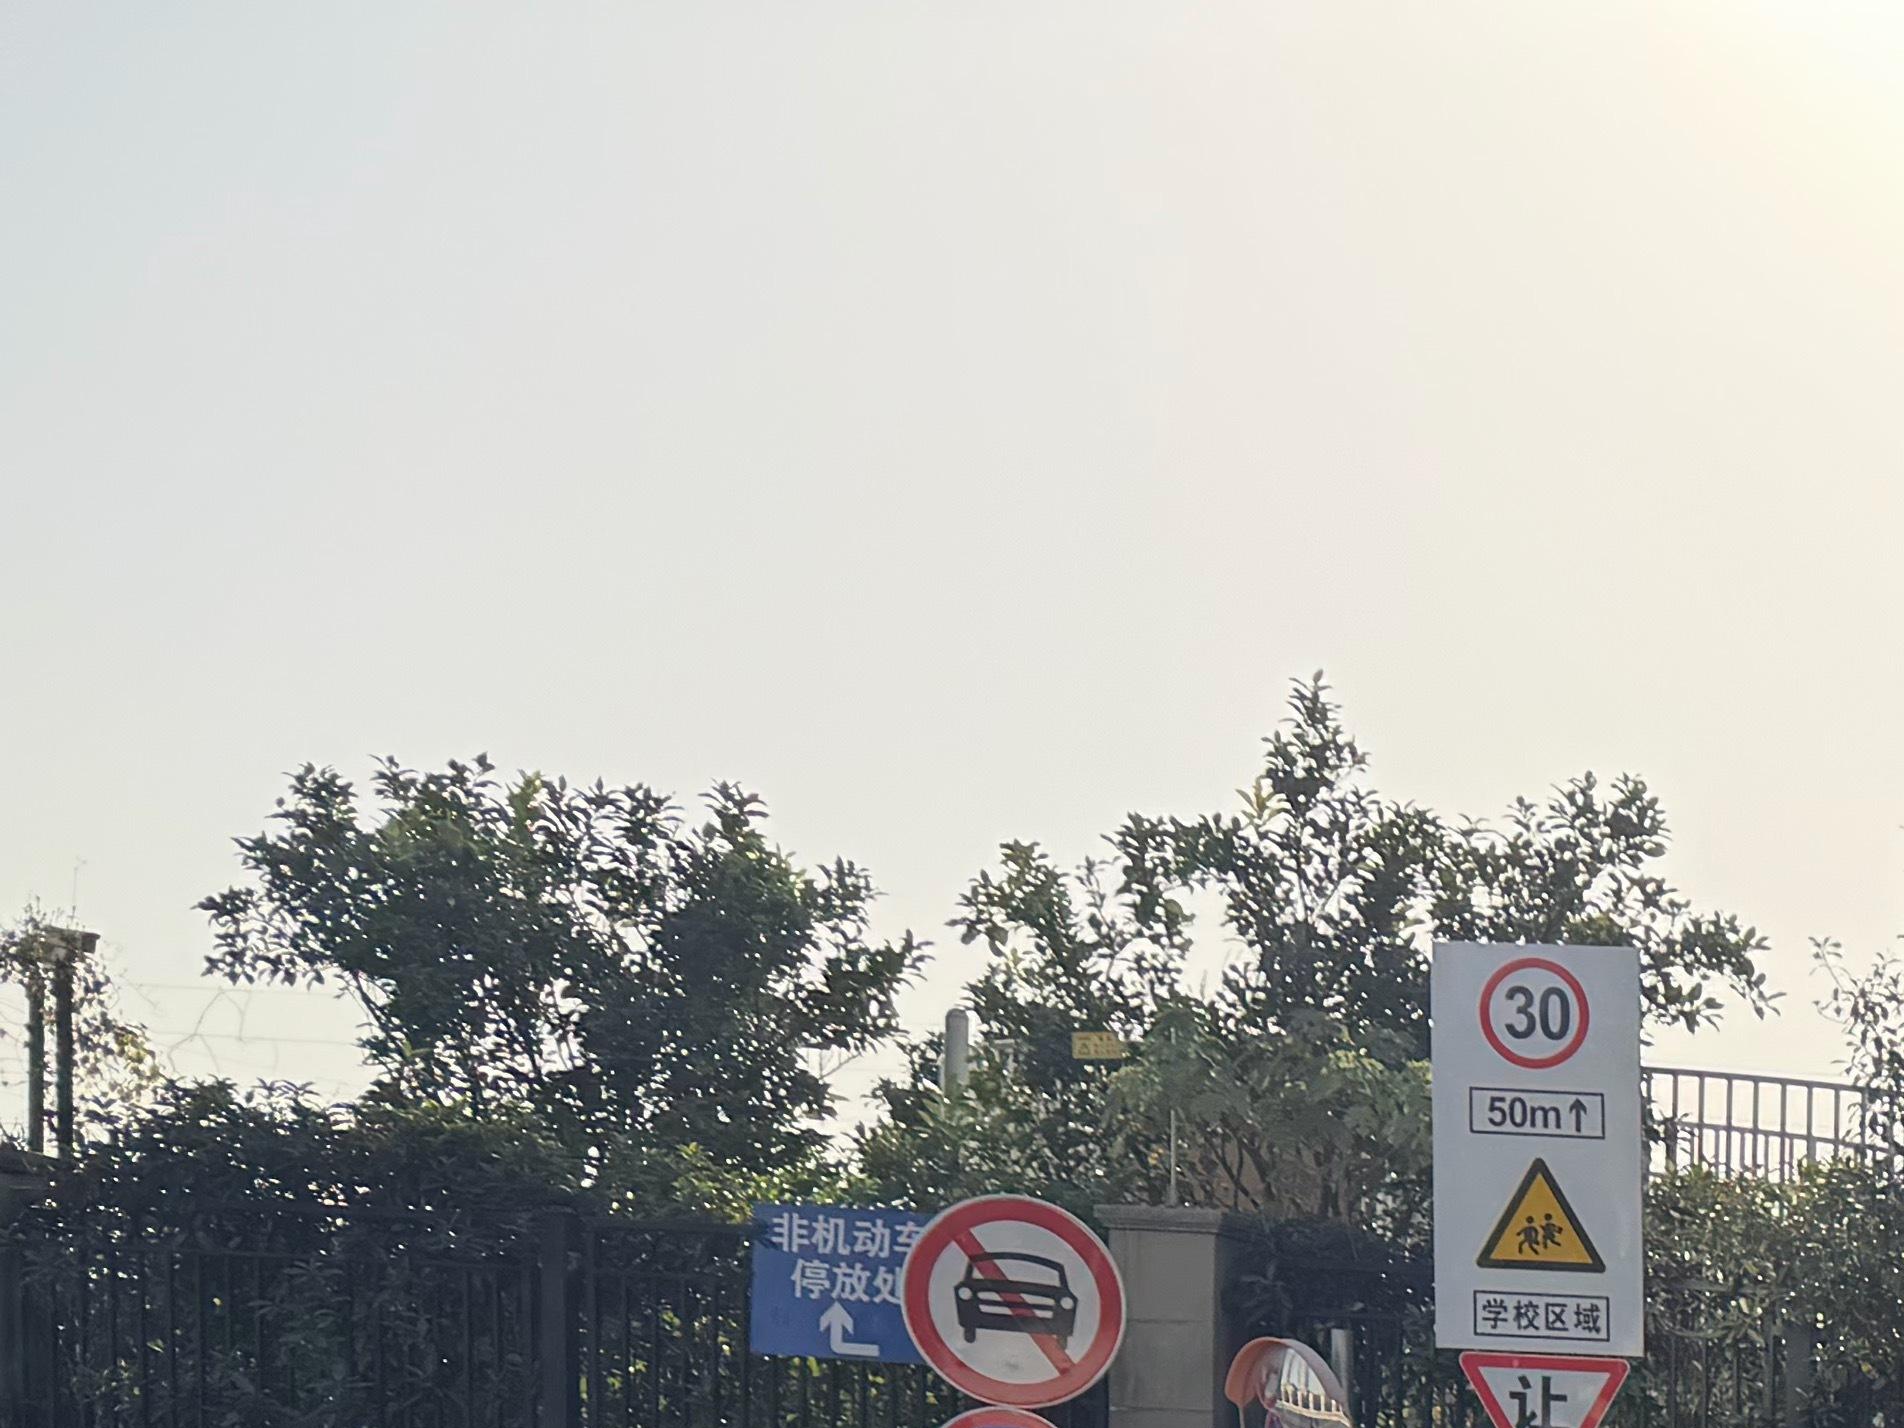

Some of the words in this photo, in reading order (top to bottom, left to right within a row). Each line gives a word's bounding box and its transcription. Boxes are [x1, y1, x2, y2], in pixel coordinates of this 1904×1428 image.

[1504, 985, 1571, 1041] 30
[1487, 1095, 1562, 1130] 50m
[790, 1257, 904, 1306] 停放处
[1481, 1297, 1602, 1335] 学校区域
